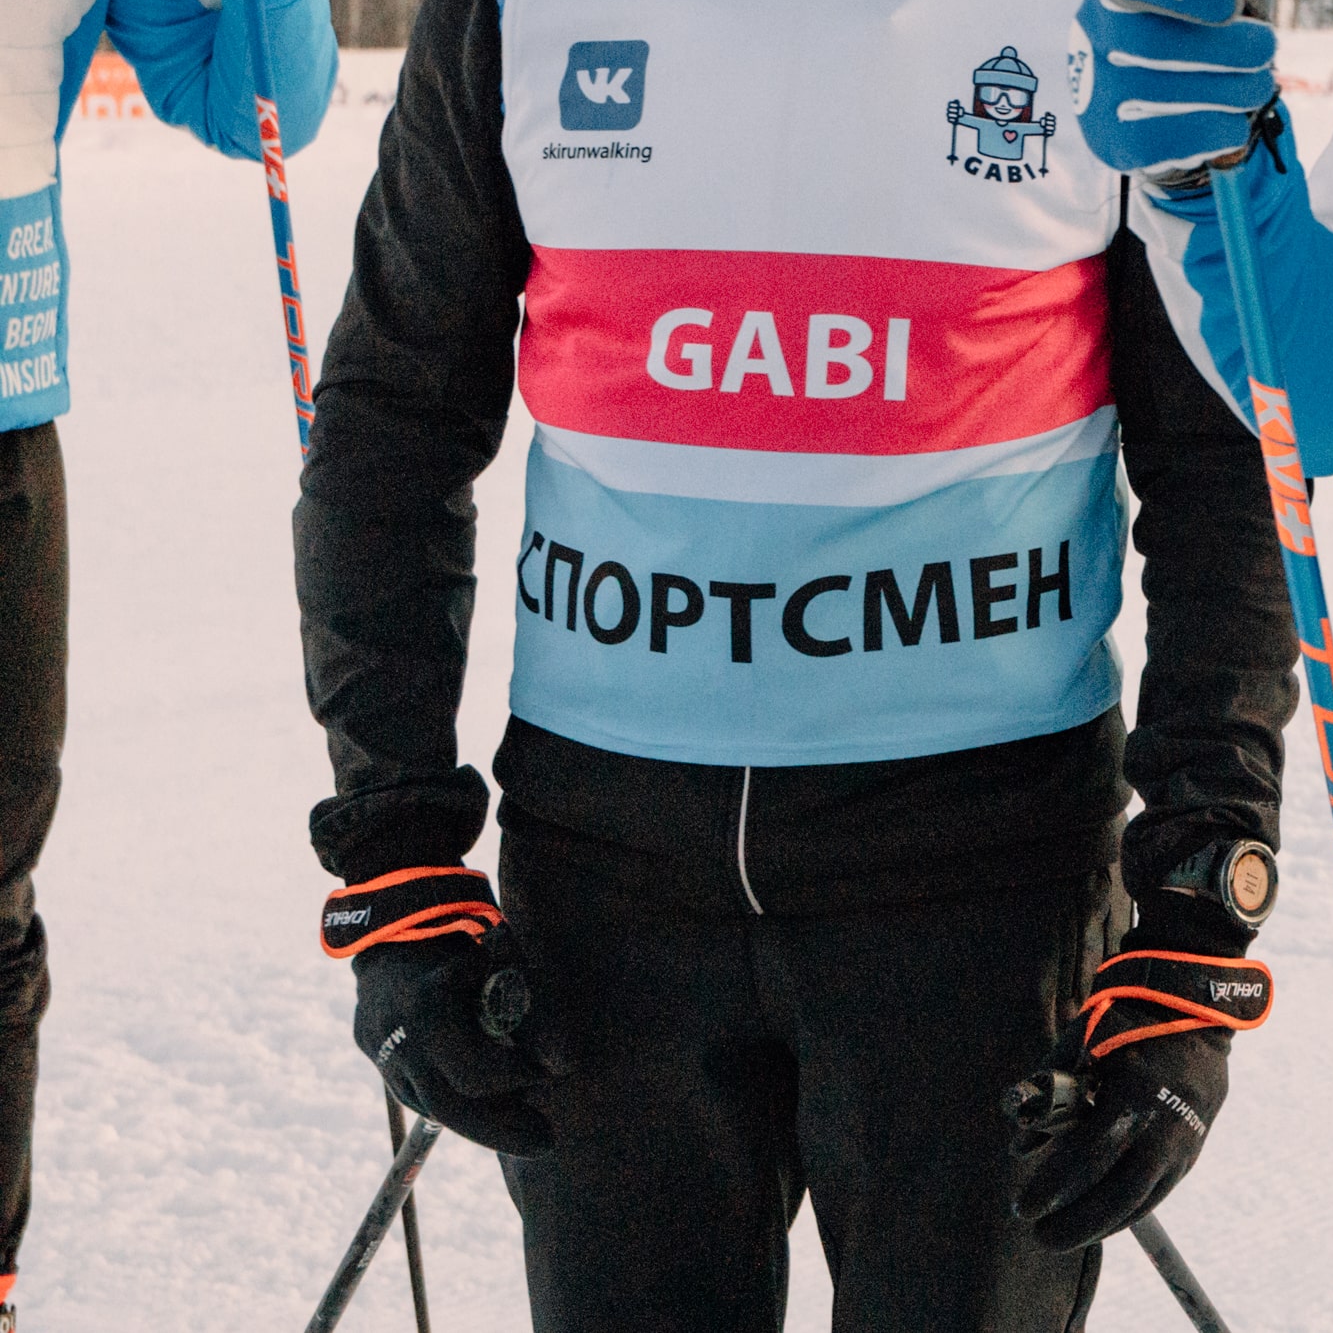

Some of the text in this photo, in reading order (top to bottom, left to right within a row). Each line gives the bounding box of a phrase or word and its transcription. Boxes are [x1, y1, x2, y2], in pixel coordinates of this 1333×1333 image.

[576, 67, 634, 104] VK
[542, 141, 653, 164] skirunwalking
[963, 156, 1037, 184] GABI
[0, 260, 61, 307] NTURE
[645, 307, 911, 402] GABI
[1250, 377, 1318, 556] KV+
[517, 529, 1074, 664] СПОРТСМЕН
